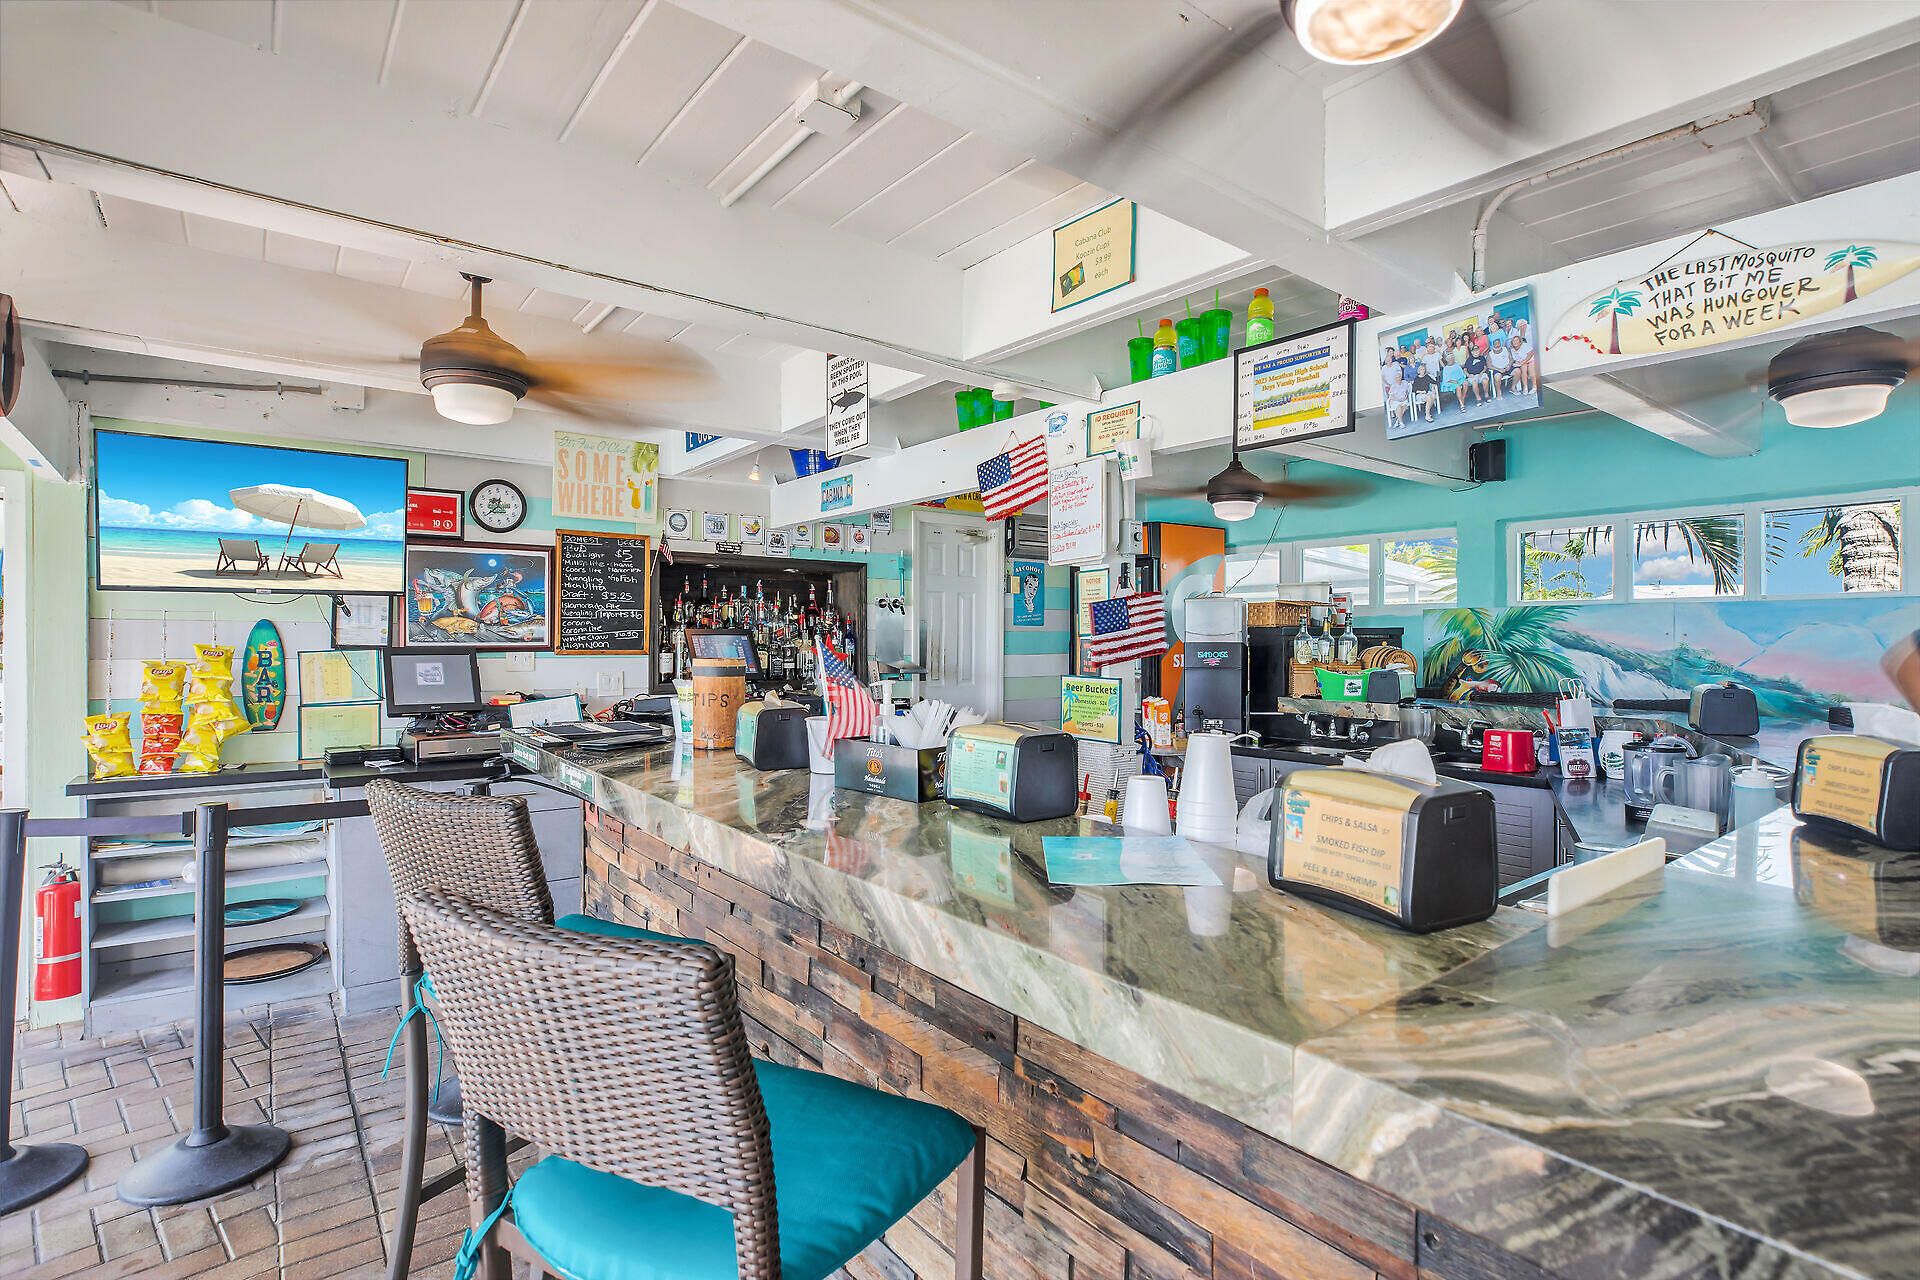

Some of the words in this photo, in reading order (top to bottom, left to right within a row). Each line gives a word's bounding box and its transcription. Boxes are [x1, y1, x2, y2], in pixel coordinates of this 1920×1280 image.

[1075, 234, 1097, 247] Cabana
[1098, 227, 1112, 238] Club
[1095, 268, 1109, 279] each
[1639, 267, 1681, 292] THE
[1685, 255, 1730, 275] LAST
[1648, 281, 1696, 309] THAT
[1745, 267, 1784, 287] ME
[1646, 302, 1695, 330] WAS
[1704, 277, 1820, 314] HUNGOVER
[1654, 323, 1696, 346] FOR
[1701, 319, 1716, 336] A
[1722, 298, 1800, 330] WEEK
[831, 357, 850, 372] SHARKS
[1276, 357, 1293, 367] PROUD
[1294, 350, 1322, 361] SUPPORTER
[830, 370, 843, 381] BEEN
[843, 360, 865, 375] SPOTTED
[838, 375, 849, 386] THIS
[849, 371, 862, 381] POOL
[1268, 371, 1294, 383] Marathon
[1294, 366, 1308, 377] High
[1309, 361, 1329, 372] School
[1262, 382, 1275, 392] Boys
[1276, 376, 1295, 389] Varsity
[1296, 372, 1320, 385] Baseball
[829, 422, 841, 432] THEY
[841, 415, 855, 426] COME
[855, 411, 866, 421] OUT
[1102, 407, 1134, 421] REQUIRED
[833, 428, 848, 439] WHEN
[848, 423, 861, 433] THEY
[835, 436, 850, 447] SMELL
[850, 431, 860, 441] PEE
[557, 448, 625, 486] SOME
[557, 480, 625, 517] WHERE
[614, 549, 633, 561] $5
[601, 591, 633, 601] $5.25
[600, 611, 629, 620] Imports
[630, 610, 643, 620] $6
[562, 641, 585, 650] High
[257, 650, 273, 703] BAR
[1066, 683, 1084, 692] Beer
[1085, 685, 1117, 695] Buckets
[693, 692, 730, 708] TIPS
[866, 747, 883, 758] Tito's
[1321, 813, 1343, 825] CHIPS
[1345, 818, 1351, 827] &
[1353, 820, 1378, 833] SALSA
[1316, 834, 1350, 850] SMOKED
[1351, 842, 1369, 854] FISH
[1370, 847, 1386, 858] DIP
[1303, 861, 1320, 873] PEEL
[1322, 866, 1328, 875] &
[1330, 868, 1344, 878] EAT
[1345, 872, 1378, 888] SHRIMP
